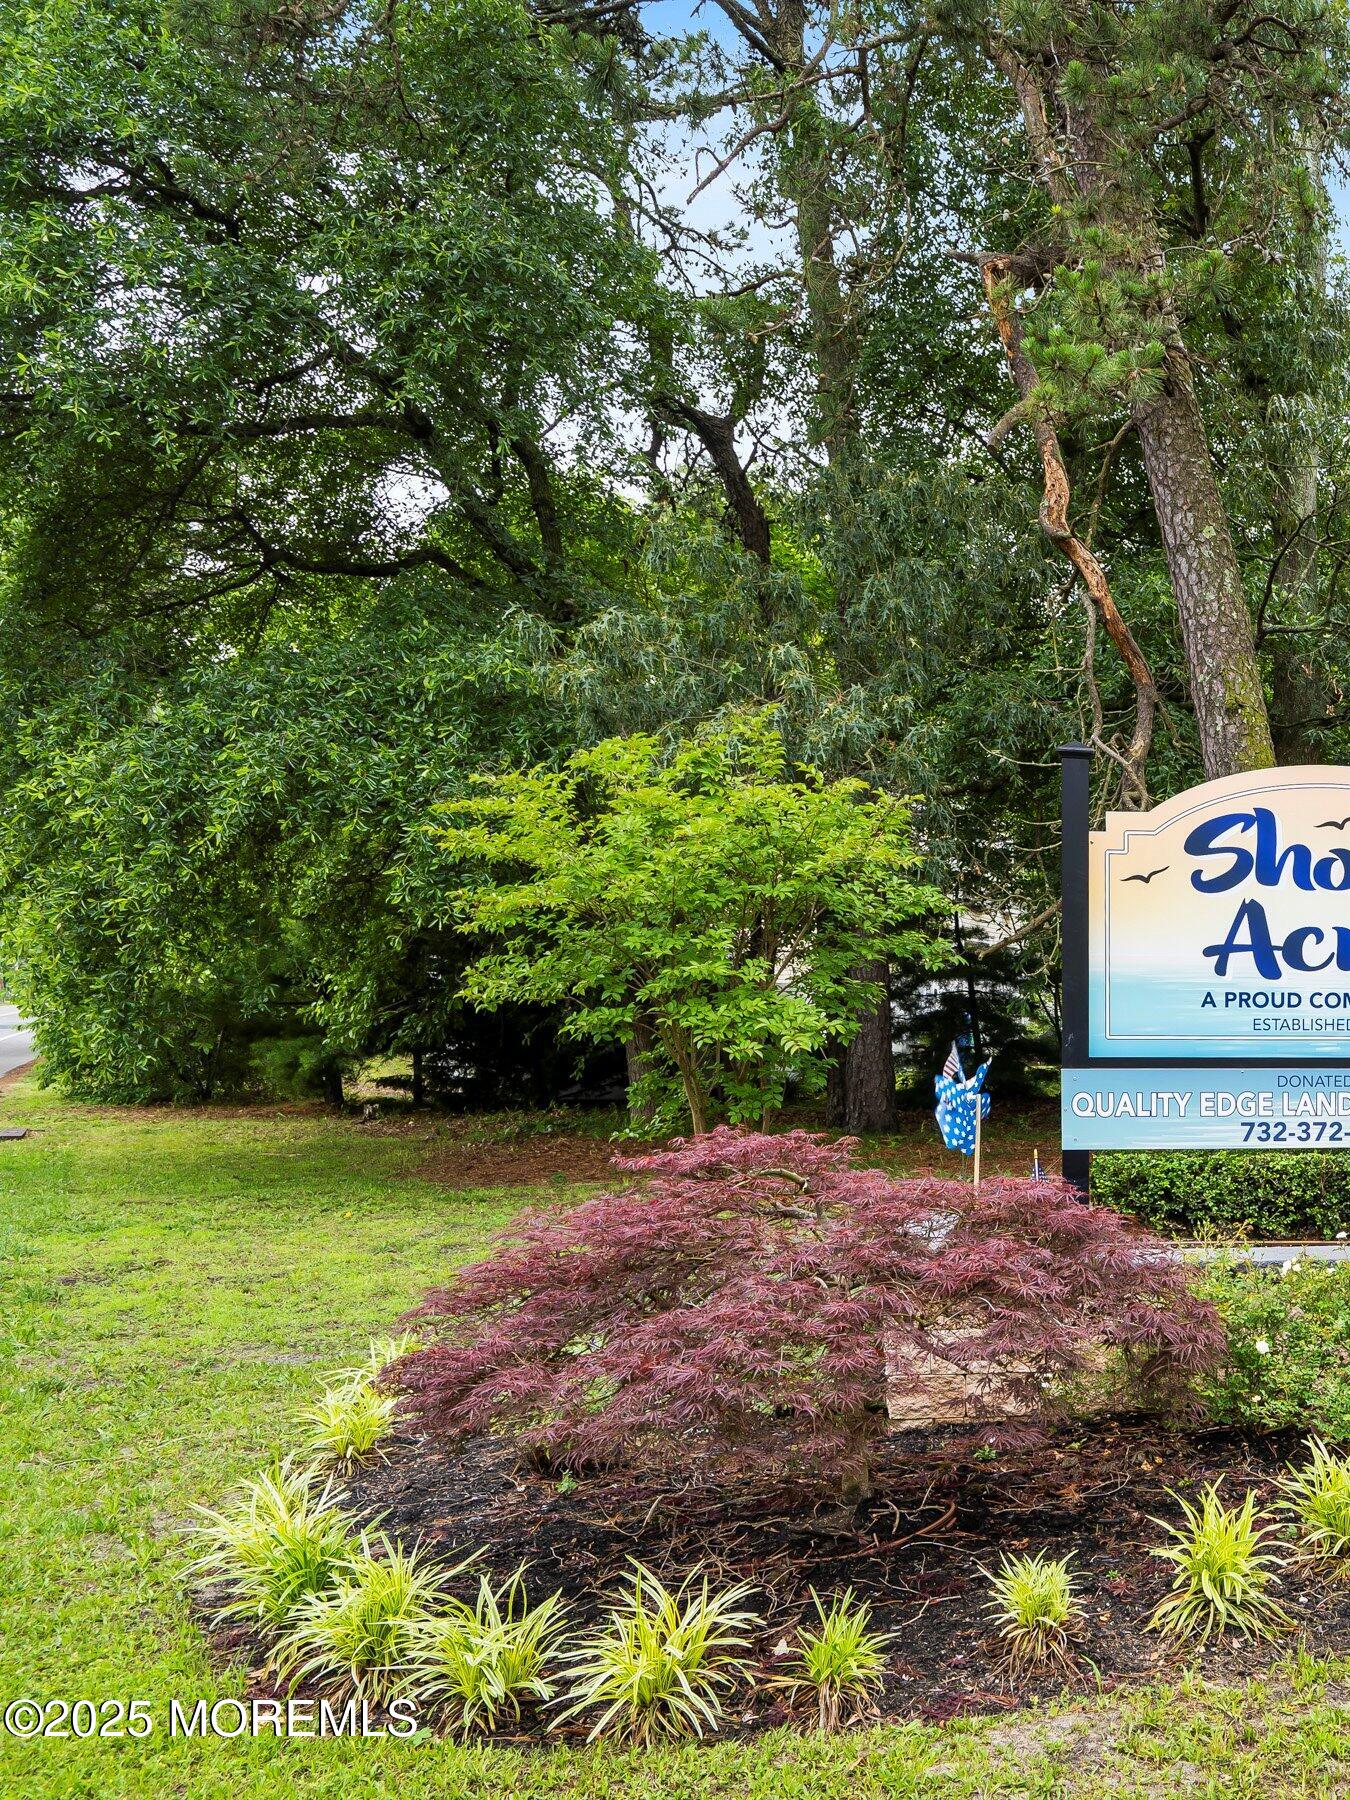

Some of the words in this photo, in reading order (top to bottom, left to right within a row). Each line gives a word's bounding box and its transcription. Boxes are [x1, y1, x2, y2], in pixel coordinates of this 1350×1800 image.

[1200, 991, 1217, 1008] A
[1224, 991, 1301, 1009] PROUD
[1071, 1091, 1194, 1118] QUALITY
[1199, 1091, 1274, 1118] EDGE
